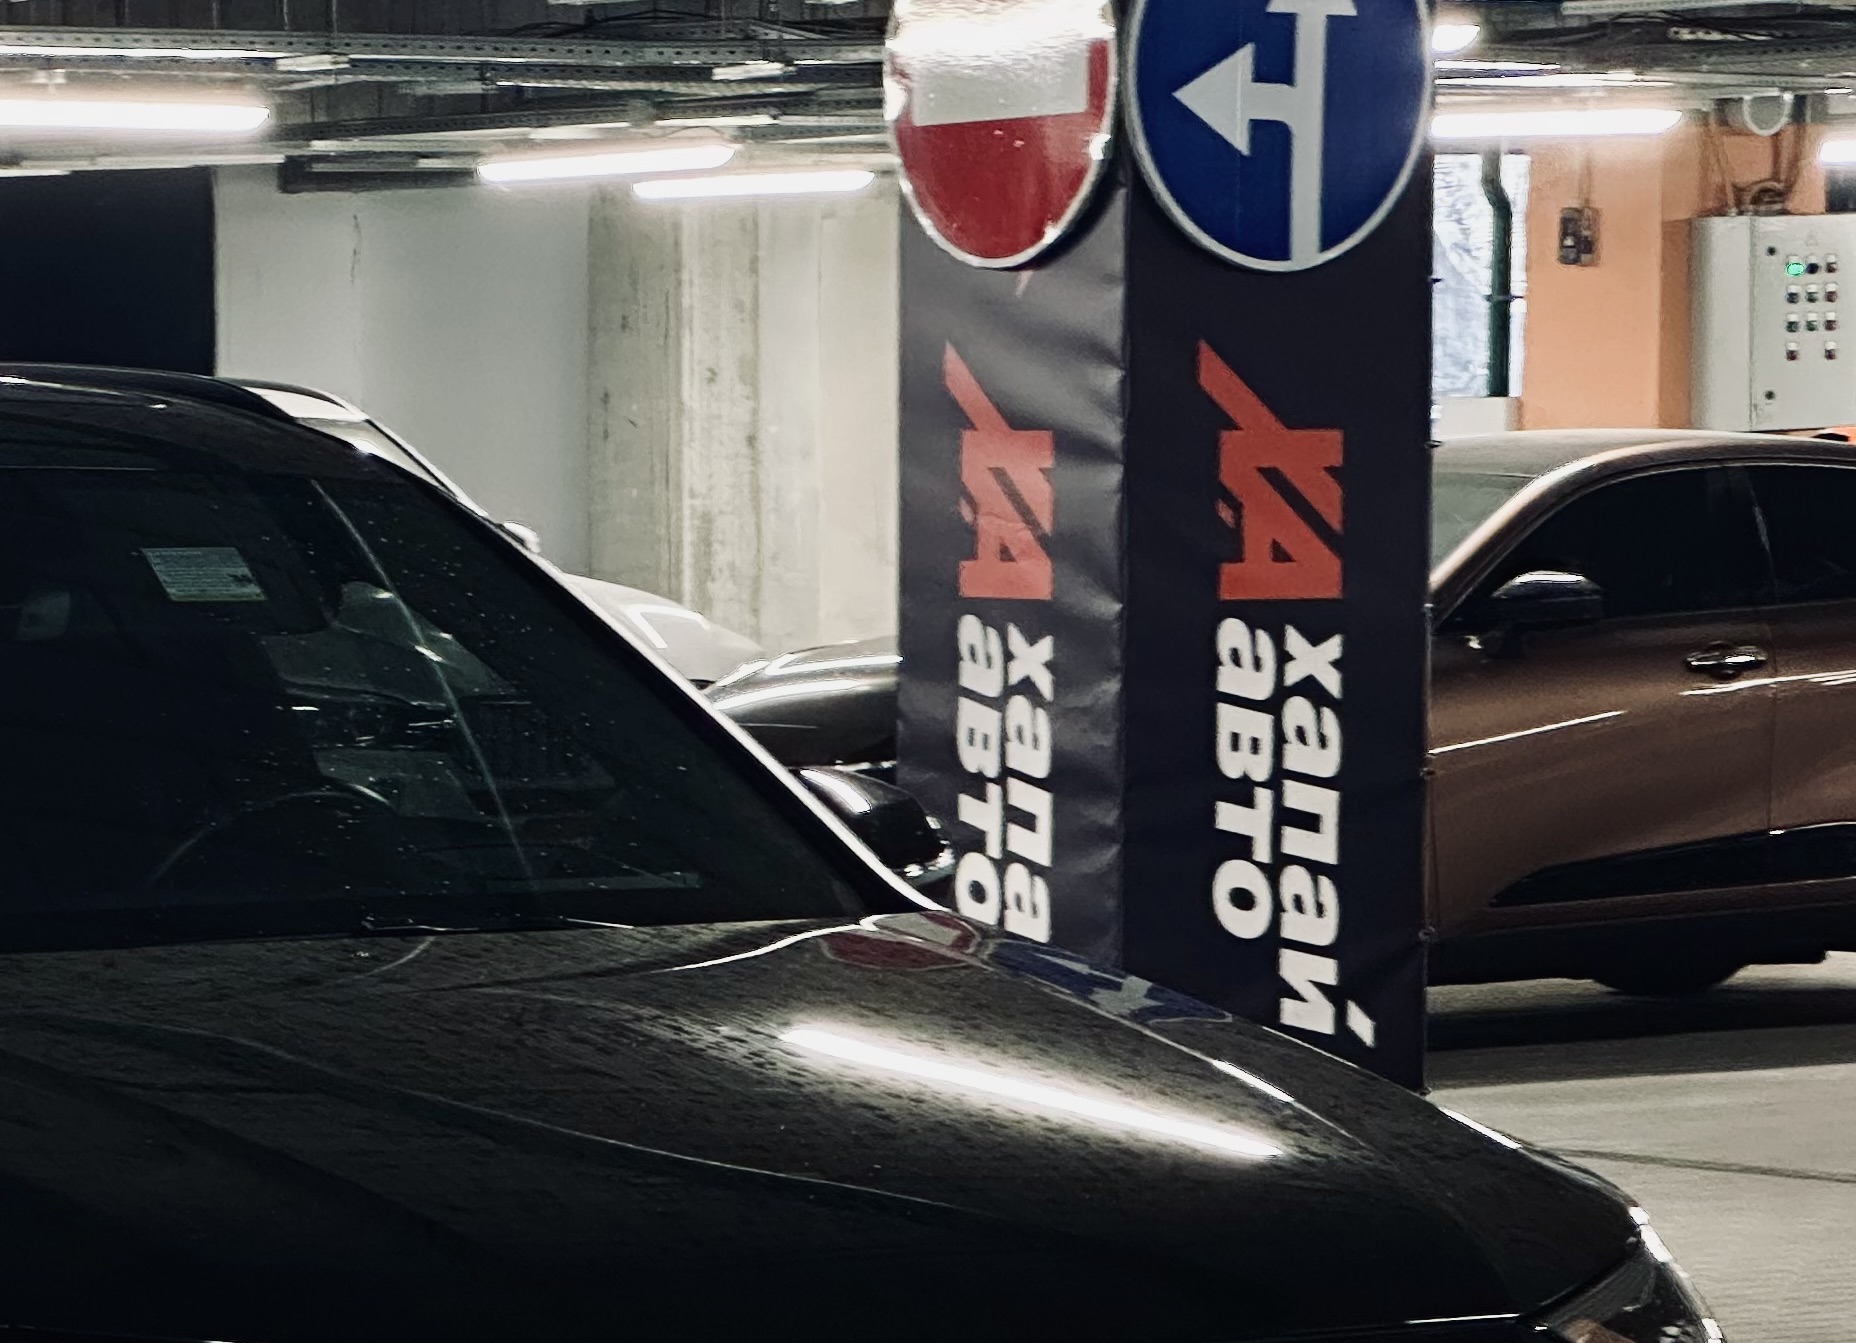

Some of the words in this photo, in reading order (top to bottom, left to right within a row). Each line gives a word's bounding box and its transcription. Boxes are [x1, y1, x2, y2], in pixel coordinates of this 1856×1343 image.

[954, 613, 1003, 927] авто
[1002, 622, 1054, 943] хапа
[1211, 616, 1276, 940] авто
[1279, 622, 1377, 1048] хапай
